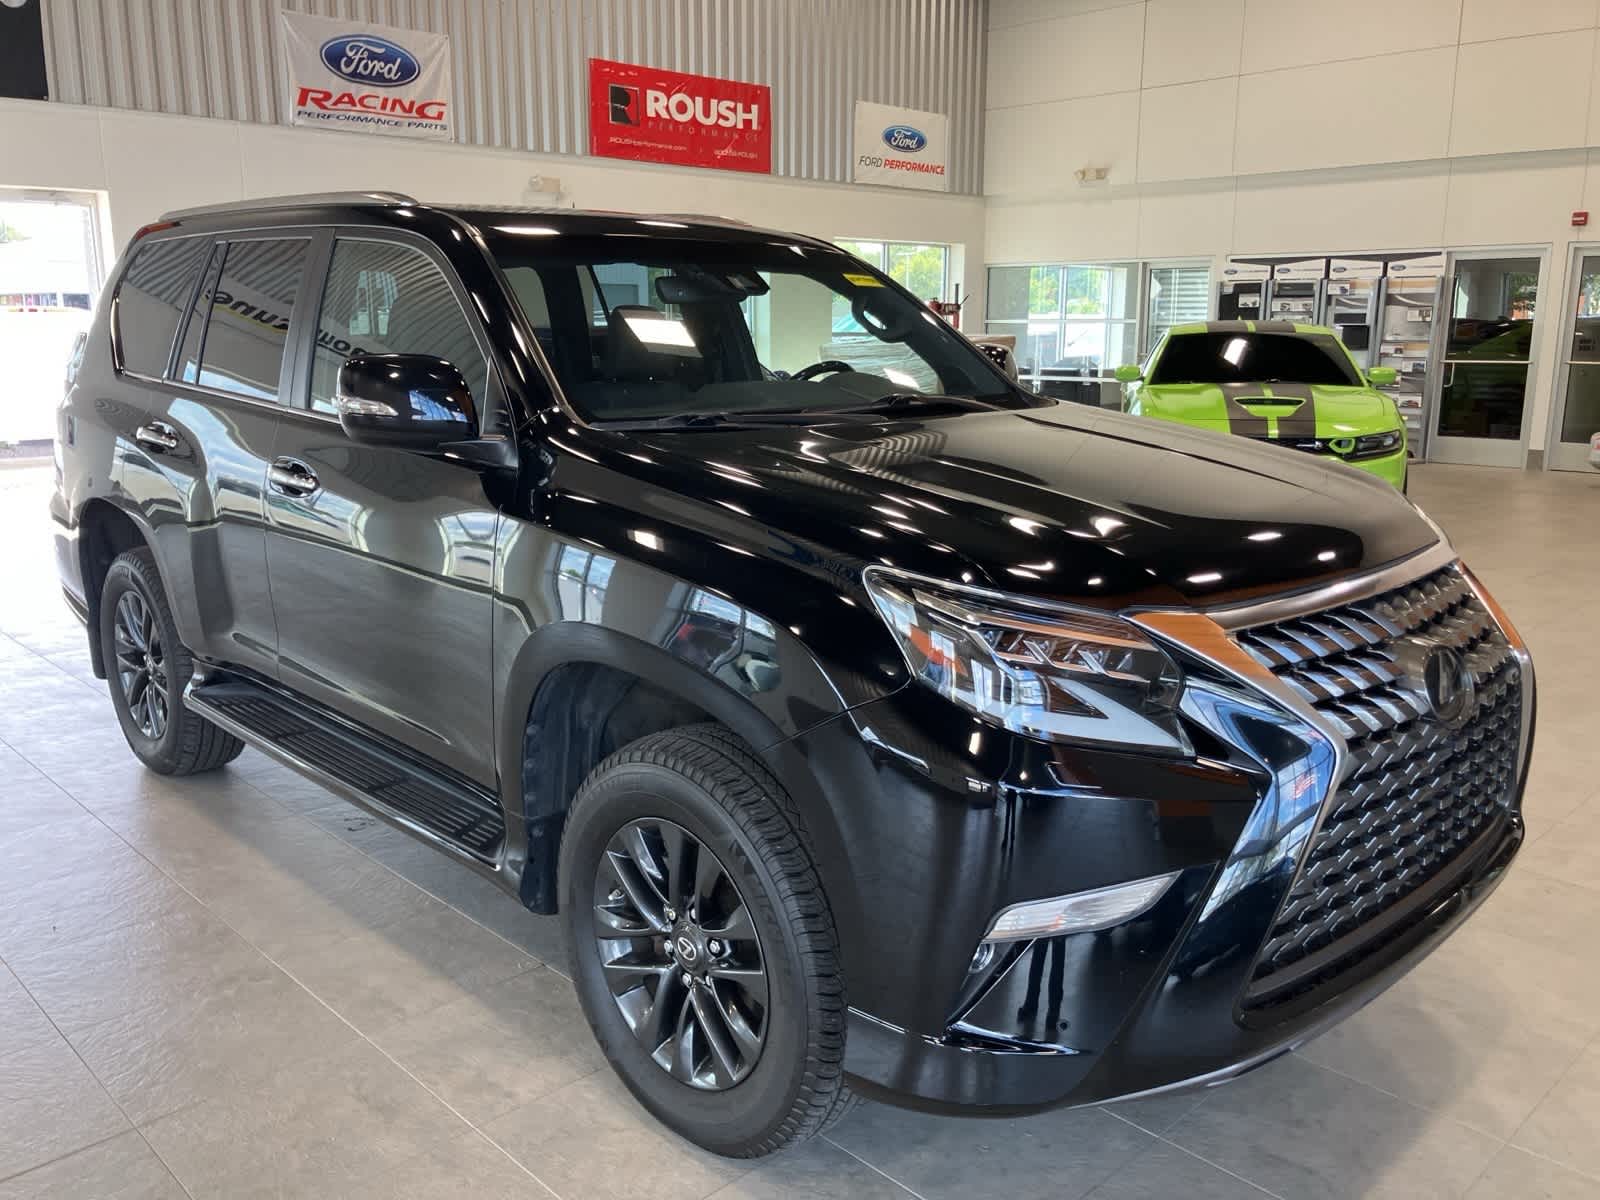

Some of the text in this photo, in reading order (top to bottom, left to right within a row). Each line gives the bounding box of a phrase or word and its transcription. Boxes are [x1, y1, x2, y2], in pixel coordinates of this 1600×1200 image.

[340, 41, 401, 81] Ford
[297, 87, 448, 121] RACING
[646, 89, 759, 131] ROUSH
[297, 110, 448, 132] PERFORMANCE PARTS
[890, 128, 919, 149] Ford
[859, 155, 945, 175] FORD PERFORMANCE
